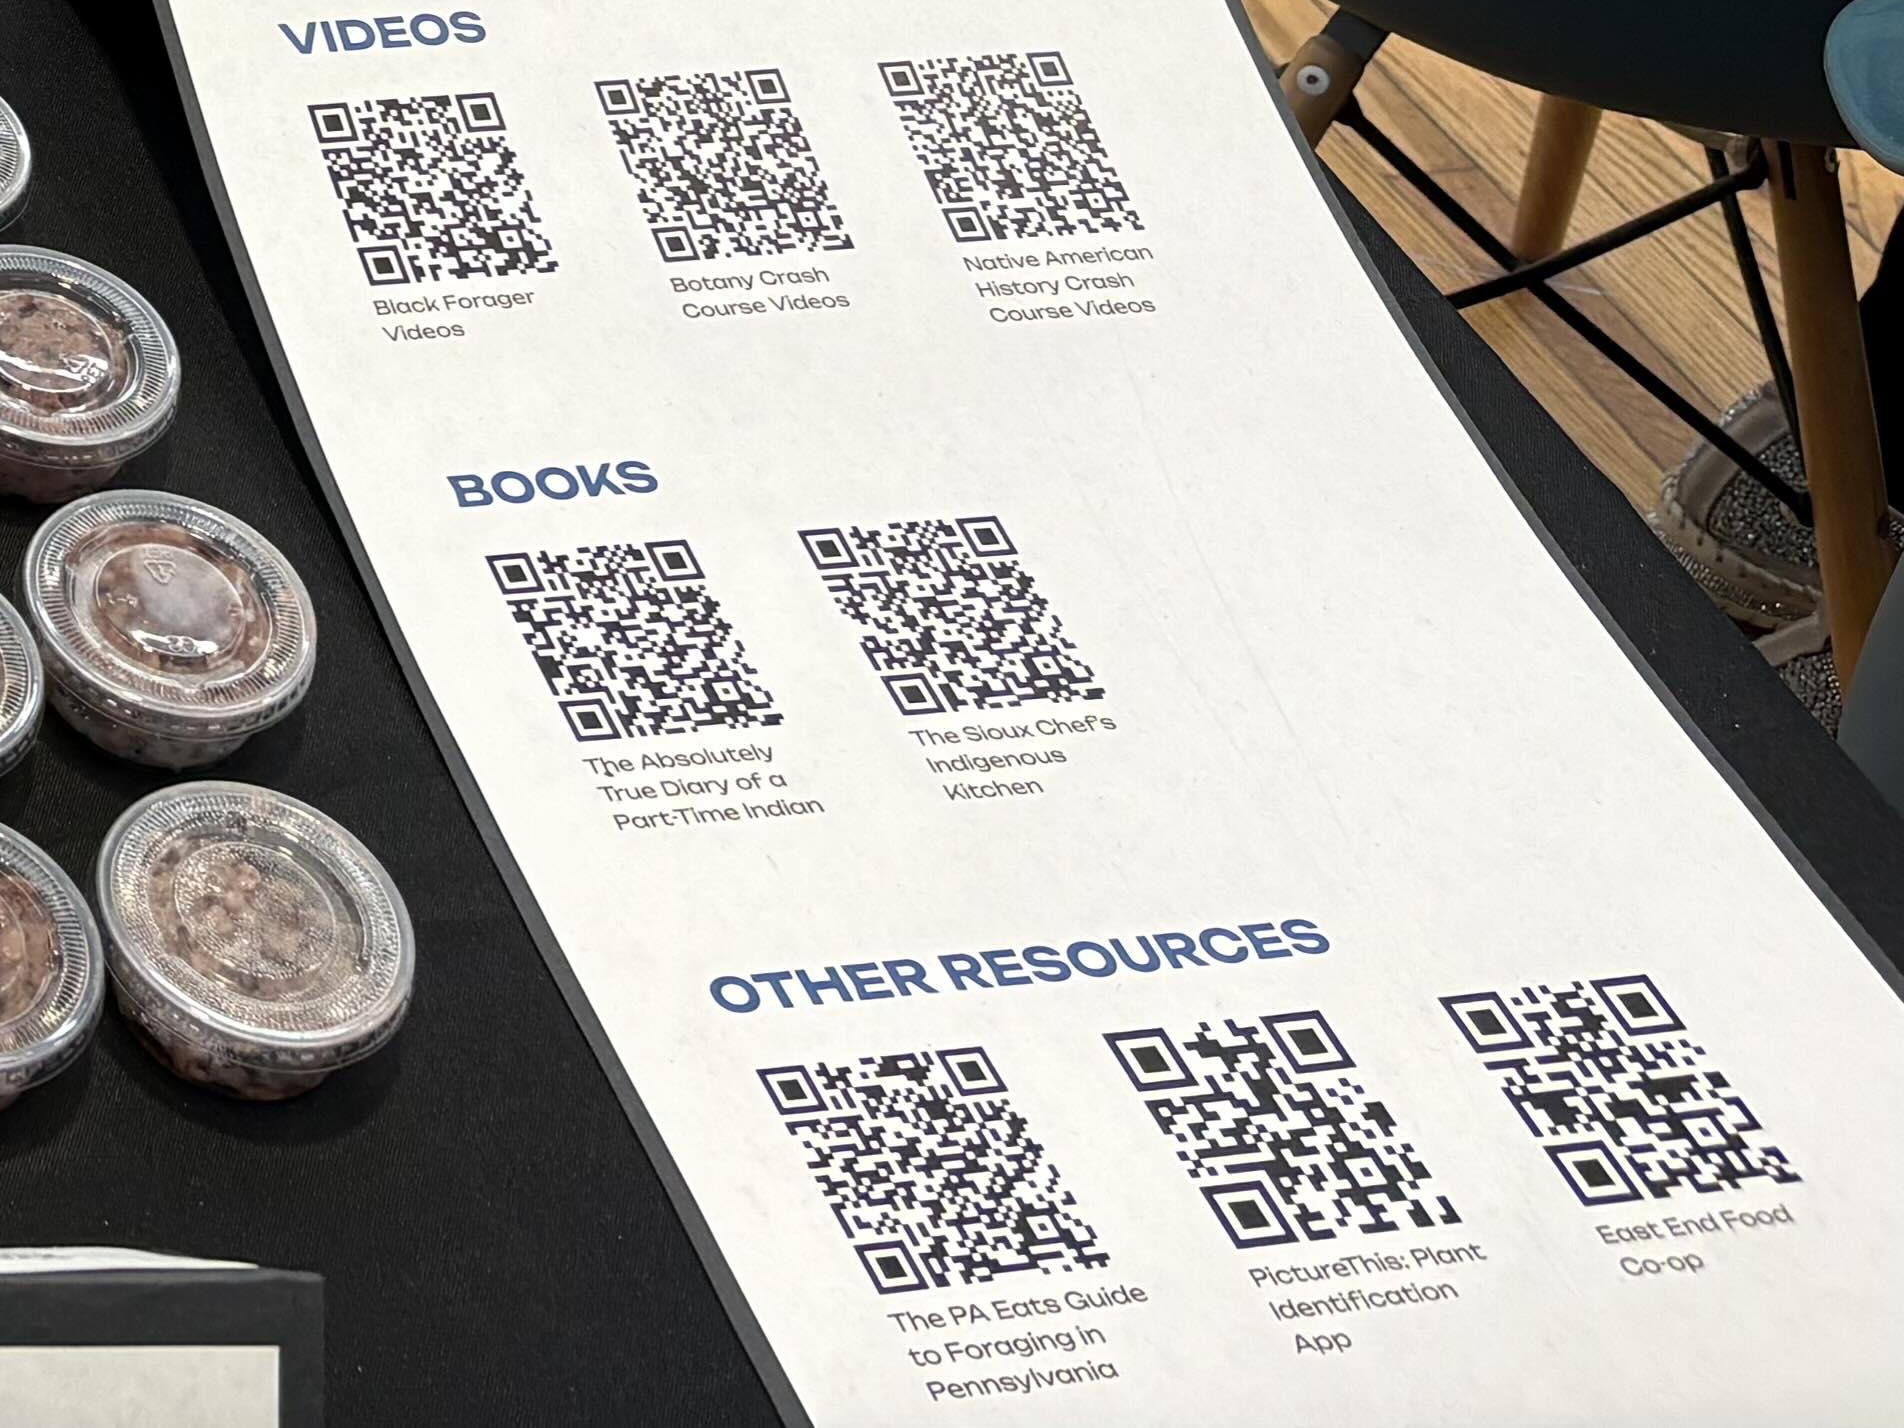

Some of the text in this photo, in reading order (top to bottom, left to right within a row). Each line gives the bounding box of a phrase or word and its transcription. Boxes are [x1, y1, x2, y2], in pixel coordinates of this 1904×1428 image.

[278, 9, 488, 57] VIDEOS
[962, 246, 1155, 272] Native American
[669, 267, 831, 293] Botany Crash
[974, 272, 1135, 299] History Crash
[372, 291, 535, 316] Black Forager
[681, 294, 851, 320] Course Videos
[988, 298, 1157, 324] Course Videos
[381, 323, 466, 342] Videos
[446, 459, 660, 509] BOOKS
[907, 715, 1118, 747] The Sioux Chef's
[581, 743, 774, 777] The Absolutely
[925, 749, 1068, 774] Indigenous
[596, 771, 788, 803] True Diary of a
[942, 779, 1044, 801] Kitchen
[612, 798, 826, 831] Part-Time Indian
[709, 917, 1332, 1014] OTHER RESOURCES
[1594, 1202, 1796, 1245] East End Food
[1247, 1242, 1489, 1289] PictureThis: Plant
[1618, 1252, 1706, 1277] Co-op
[886, 1284, 1150, 1334] The PA Eats Guide
[1267, 1282, 1461, 1322] Identification
[907, 1324, 1108, 1368] to Foraging in
[1294, 1330, 1354, 1356] App
[925, 1359, 1121, 1403] Pennsylvania
